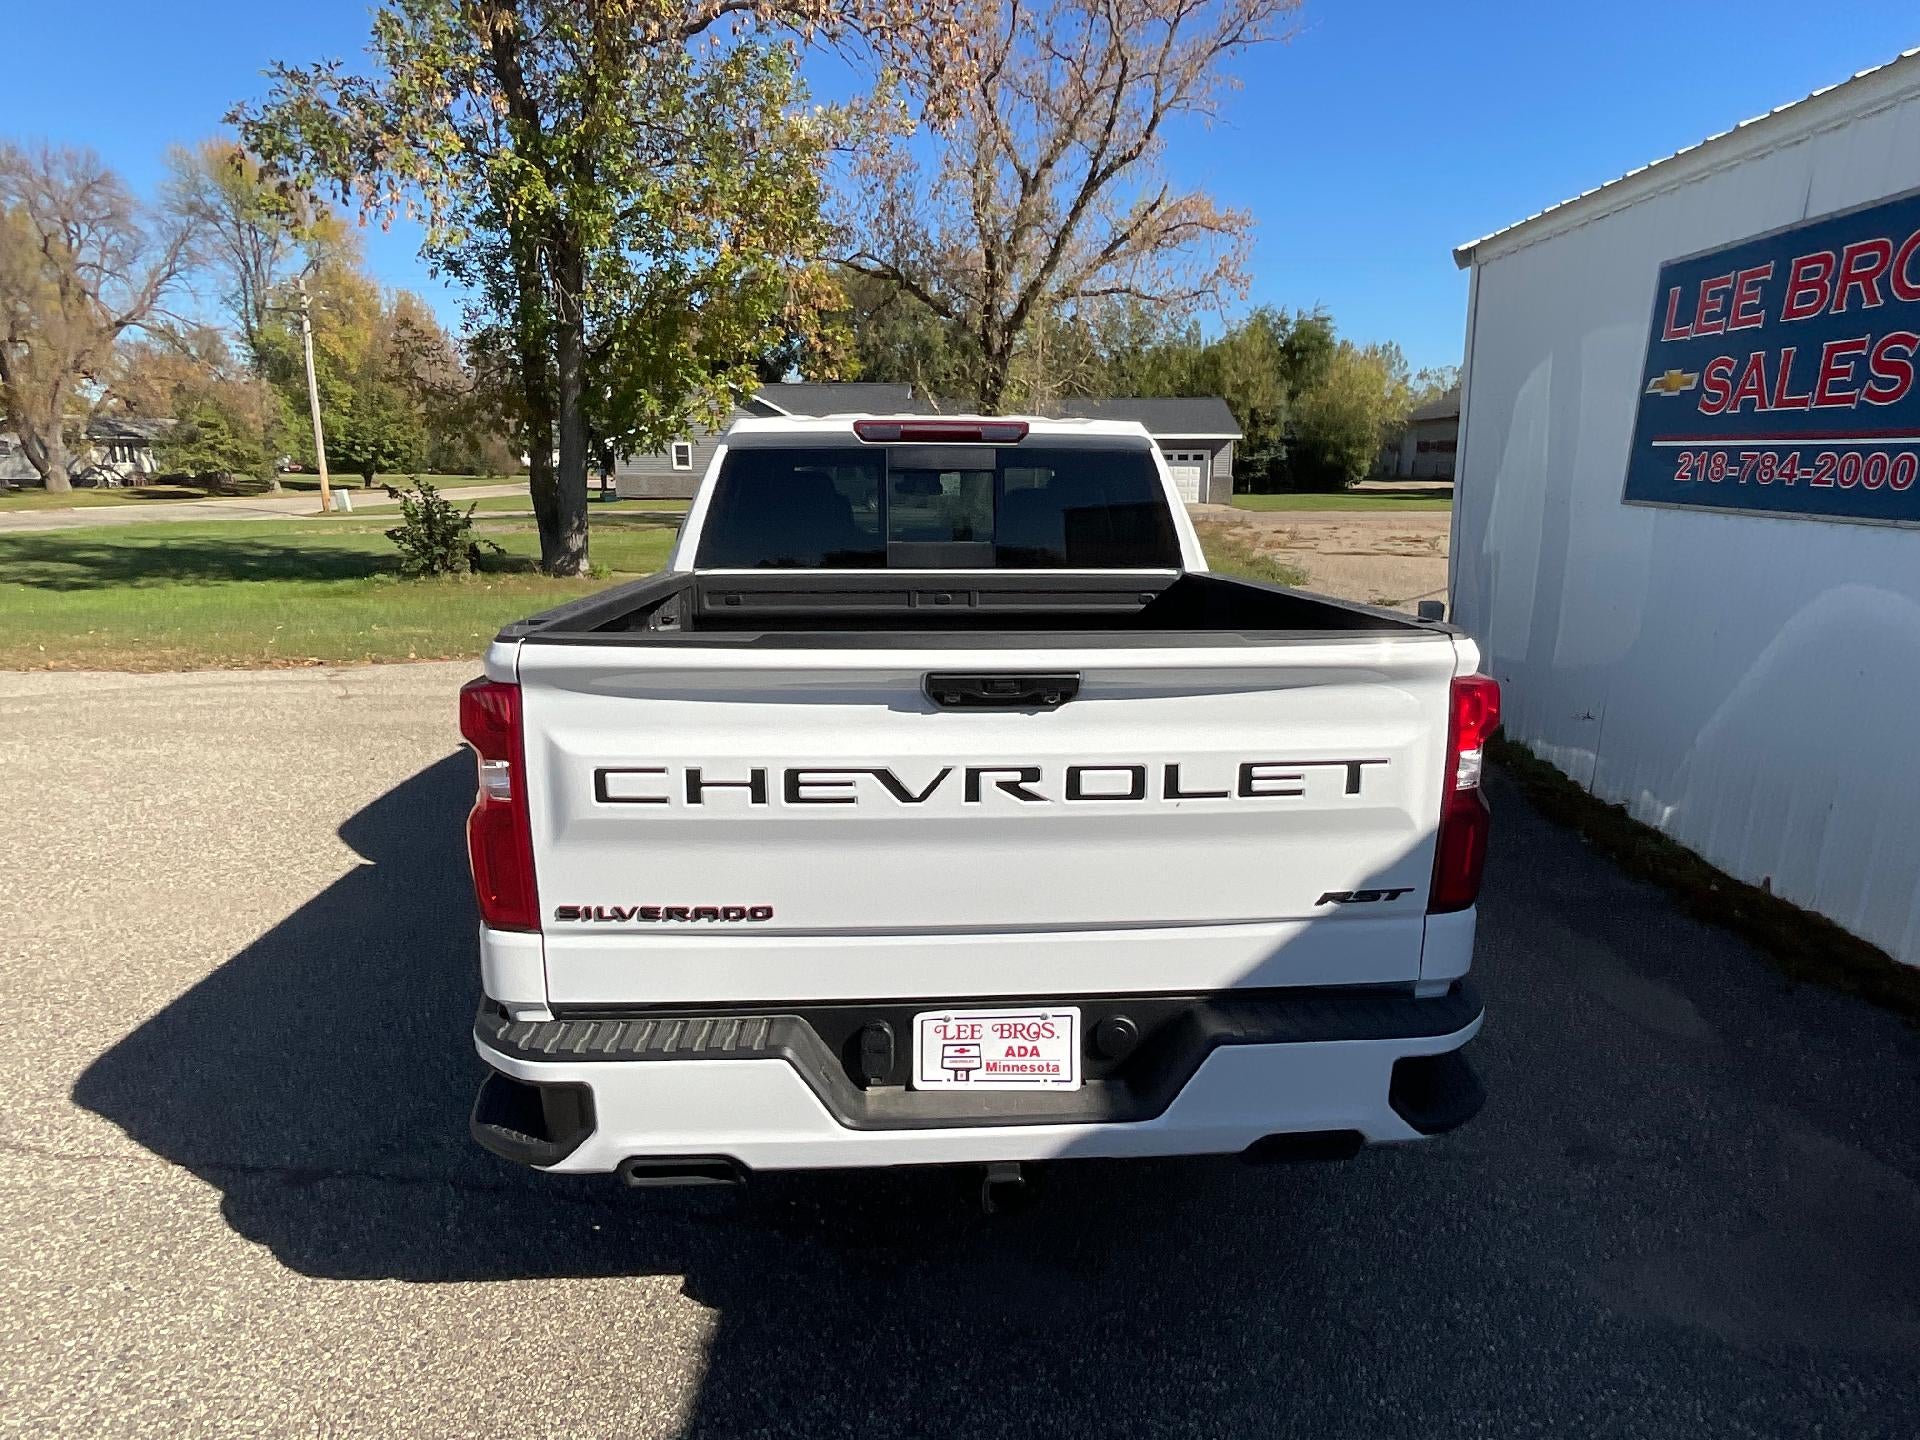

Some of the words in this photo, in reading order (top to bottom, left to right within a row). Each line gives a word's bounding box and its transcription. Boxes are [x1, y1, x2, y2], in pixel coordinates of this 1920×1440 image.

[1661, 260, 1774, 342] LEE
[1697, 331, 1920, 415] SALES
[1674, 451, 1919, 491] 218-784-2000
[594, 757, 1391, 804] CHEVROLET
[1314, 887, 1416, 906] RST
[554, 904, 775, 923] SILVERADO
[934, 1023, 984, 1041] LEE
[991, 1022, 1060, 1042] BROS.
[1004, 1045, 1041, 1058] ADA
[985, 1061, 1060, 1073] Minnesota
